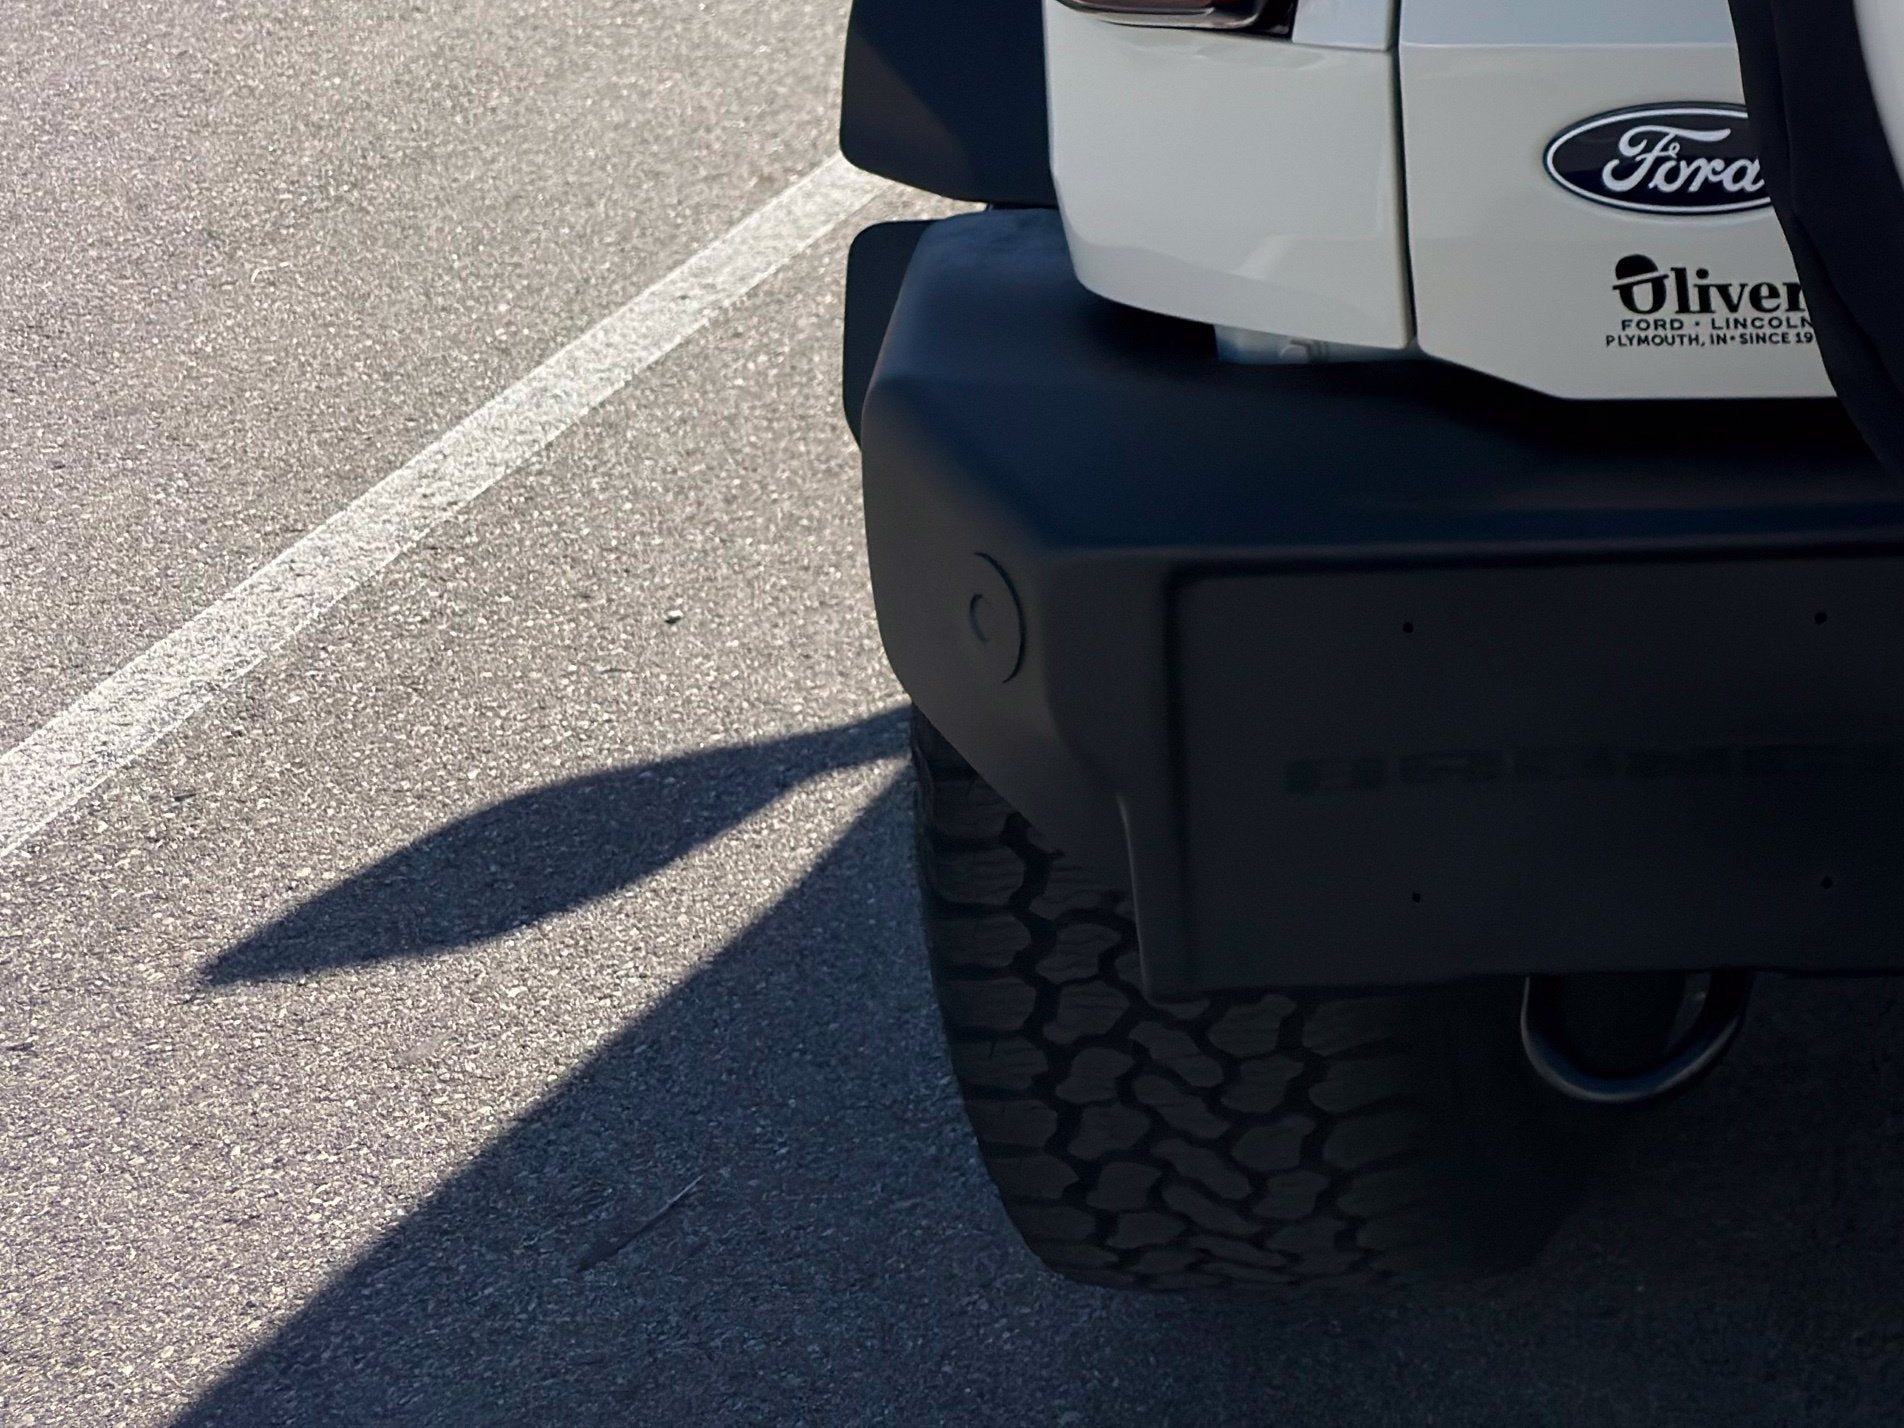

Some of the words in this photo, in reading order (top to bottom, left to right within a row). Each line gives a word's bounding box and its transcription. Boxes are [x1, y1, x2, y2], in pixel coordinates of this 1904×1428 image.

[1612, 254, 1805, 315] Oliver
[1621, 318, 1685, 332] FORD
[1605, 333, 1705, 348] PLYMOUTH,
[1795, 331, 1815, 344] 19
